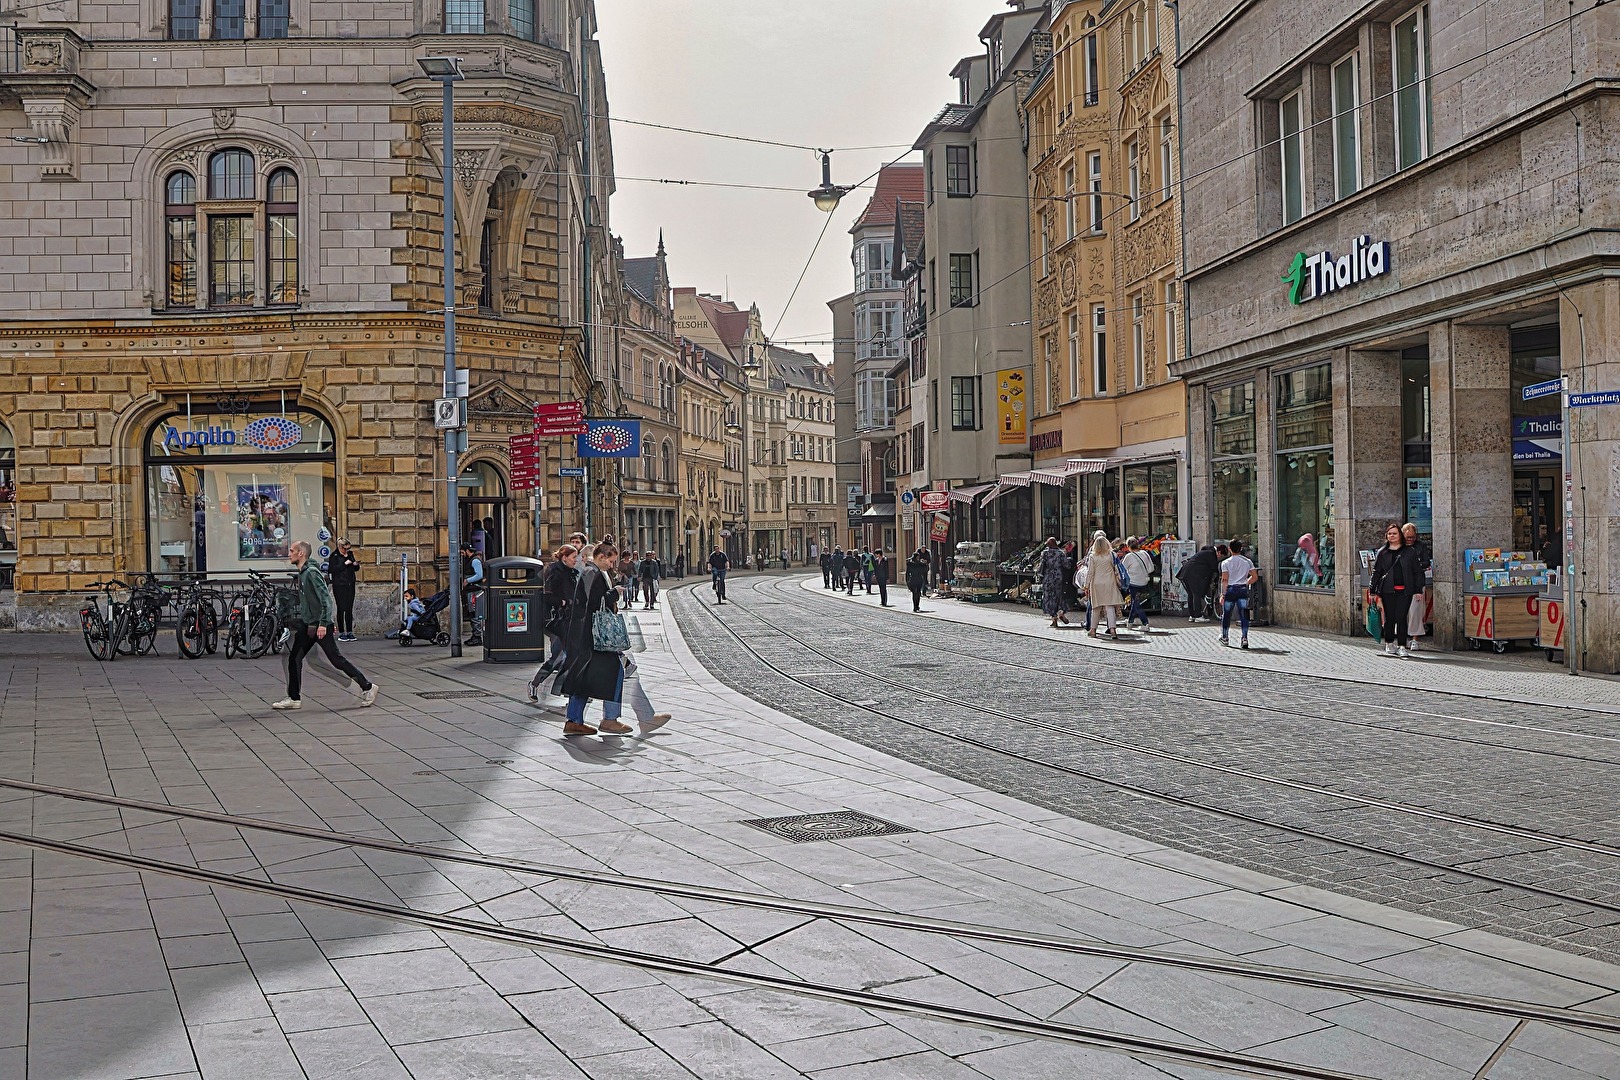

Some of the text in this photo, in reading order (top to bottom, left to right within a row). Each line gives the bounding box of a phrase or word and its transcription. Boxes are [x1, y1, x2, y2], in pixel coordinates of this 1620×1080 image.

[1306, 234, 1387, 297] Thalia
[1525, 382, 1560, 397] Schmeerstraße
[1572, 394, 1620, 405] Marktplatz
[165, 426, 236, 450] Apollo
[1470, 596, 1493, 638] %
